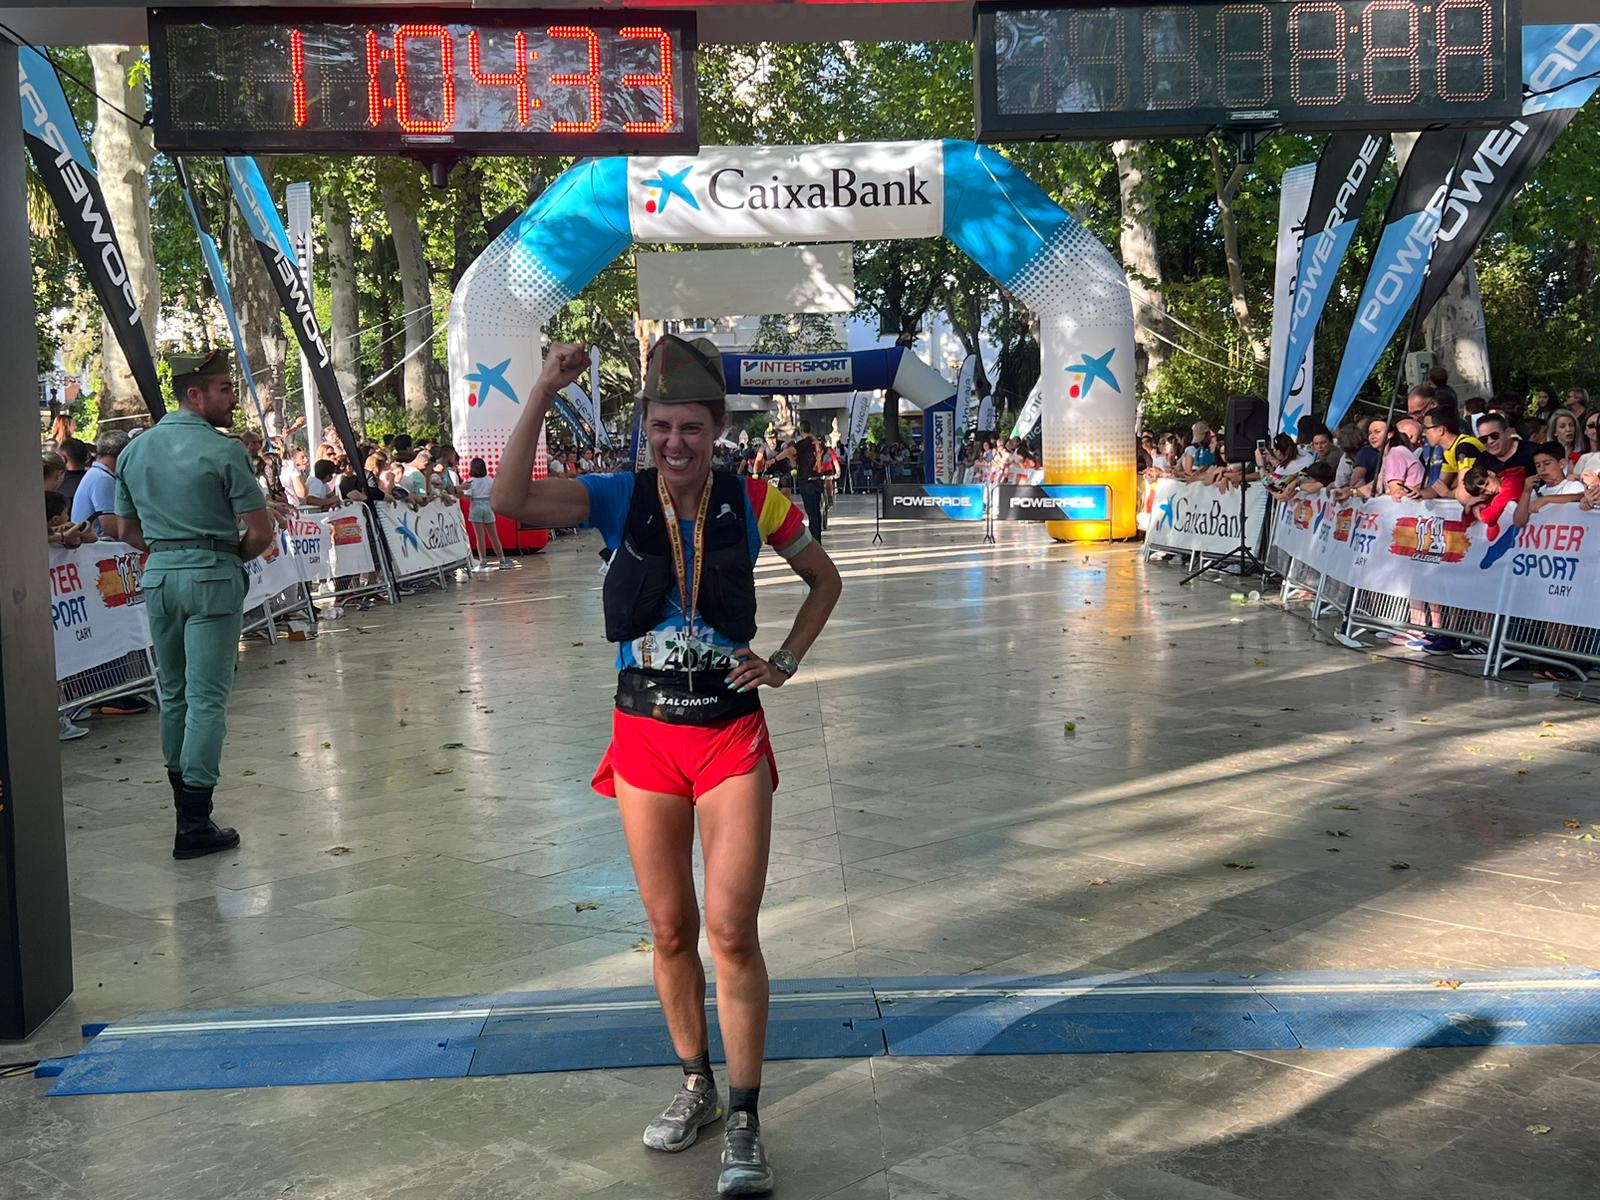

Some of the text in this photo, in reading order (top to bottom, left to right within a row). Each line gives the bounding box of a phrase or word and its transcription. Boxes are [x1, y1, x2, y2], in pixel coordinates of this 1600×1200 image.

[290, 25, 672, 133] 11:04:33
[708, 168, 931, 210] CaixaBank
[1290, 133, 1382, 344] POWERADE
[760, 359, 848, 373] INTERSPORT
[893, 496, 971, 506] POWERADE
[1010, 497, 1095, 508] POWERADE
[1518, 524, 1585, 552] INTER
[1512, 553, 1579, 581] SPORT
[1548, 584, 1572, 597] CARY
[75, 626, 93, 641] CARY
[657, 696, 718, 707] SALOMON
